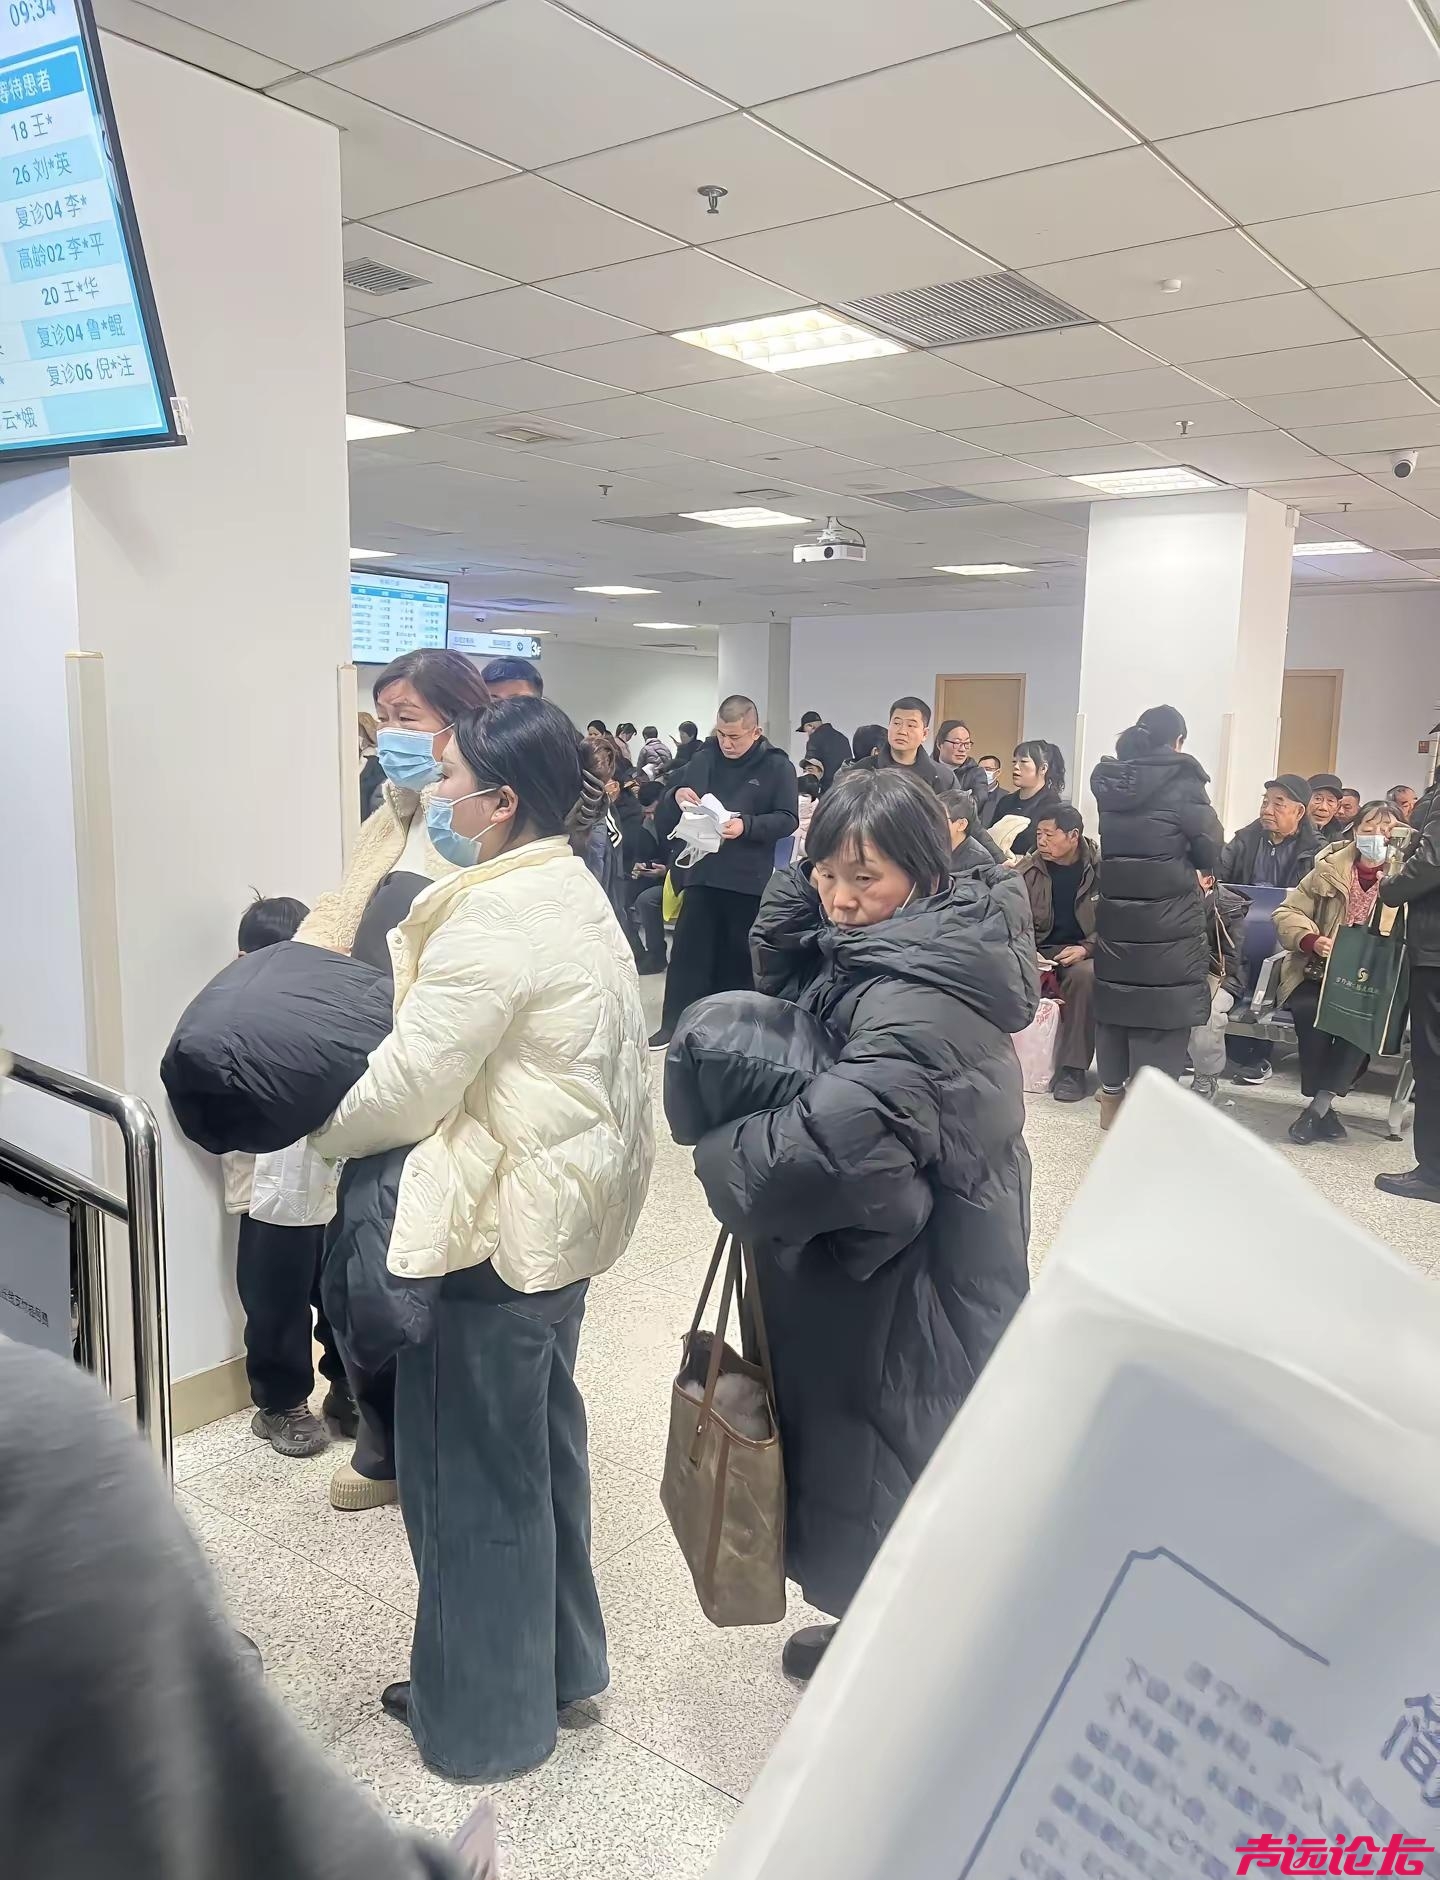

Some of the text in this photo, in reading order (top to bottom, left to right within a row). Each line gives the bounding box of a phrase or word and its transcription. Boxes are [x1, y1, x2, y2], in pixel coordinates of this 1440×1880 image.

[9, 0, 56, 27] 09:34
[0, 69, 52, 105] 等待患者
[11, 120, 29, 142] 18
[12, 163, 31, 186] 26
[15, 200, 63, 230] 复诊04
[17, 243, 66, 271] 高龄02
[41, 286, 60, 306] 20
[36, 323, 84, 349] 复诊04
[46, 362, 93, 387] 复诊06
